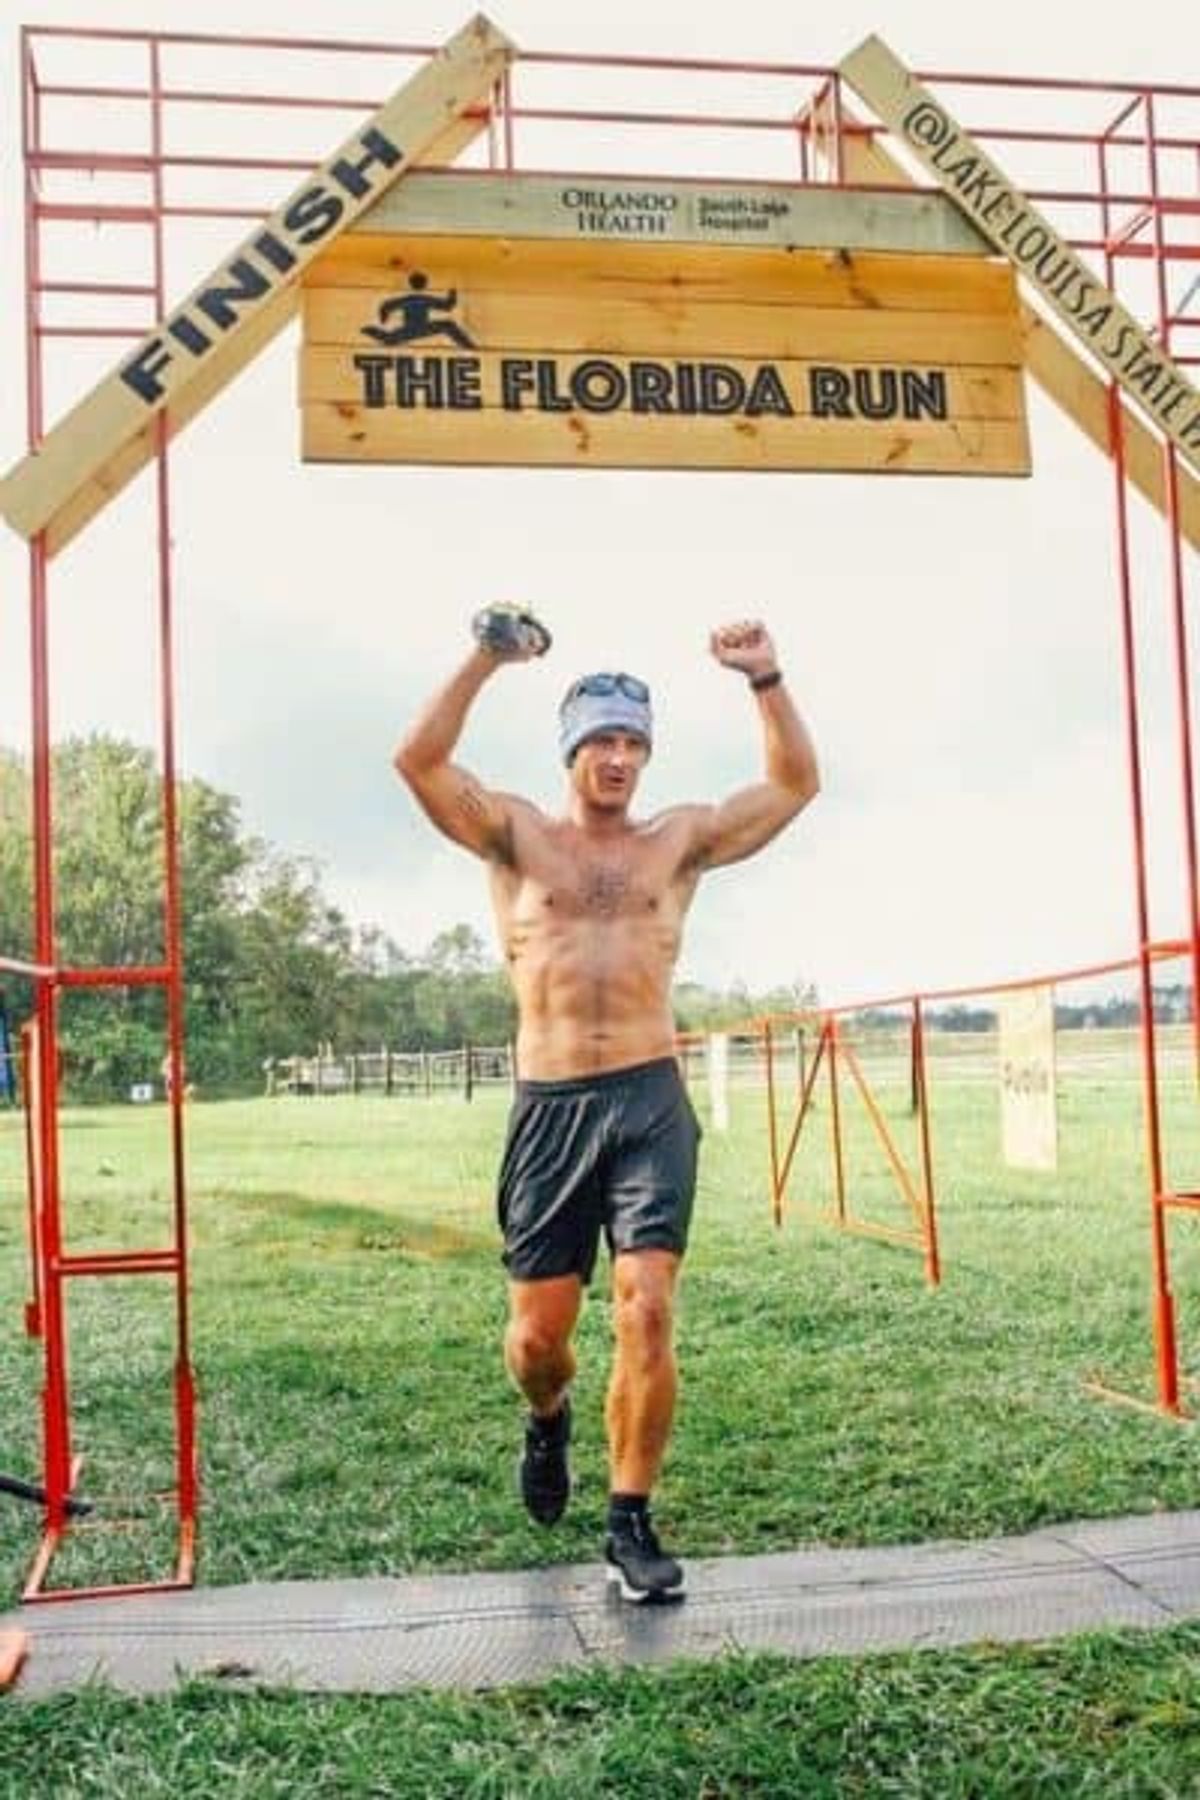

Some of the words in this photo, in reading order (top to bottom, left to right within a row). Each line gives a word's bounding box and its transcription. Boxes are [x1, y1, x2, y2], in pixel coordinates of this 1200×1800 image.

[562, 188, 679, 211] ORLANDO
[578, 211, 666, 233] HEALTH
[120, 127, 403, 405] FINISH
[1000, 210, 1114, 338] LOUISA
[1103, 324, 1194, 421] STATE
[354, 354, 482, 409] THE
[500, 359, 795, 418] FLORIDA
[808, 366, 948, 421] RUN
